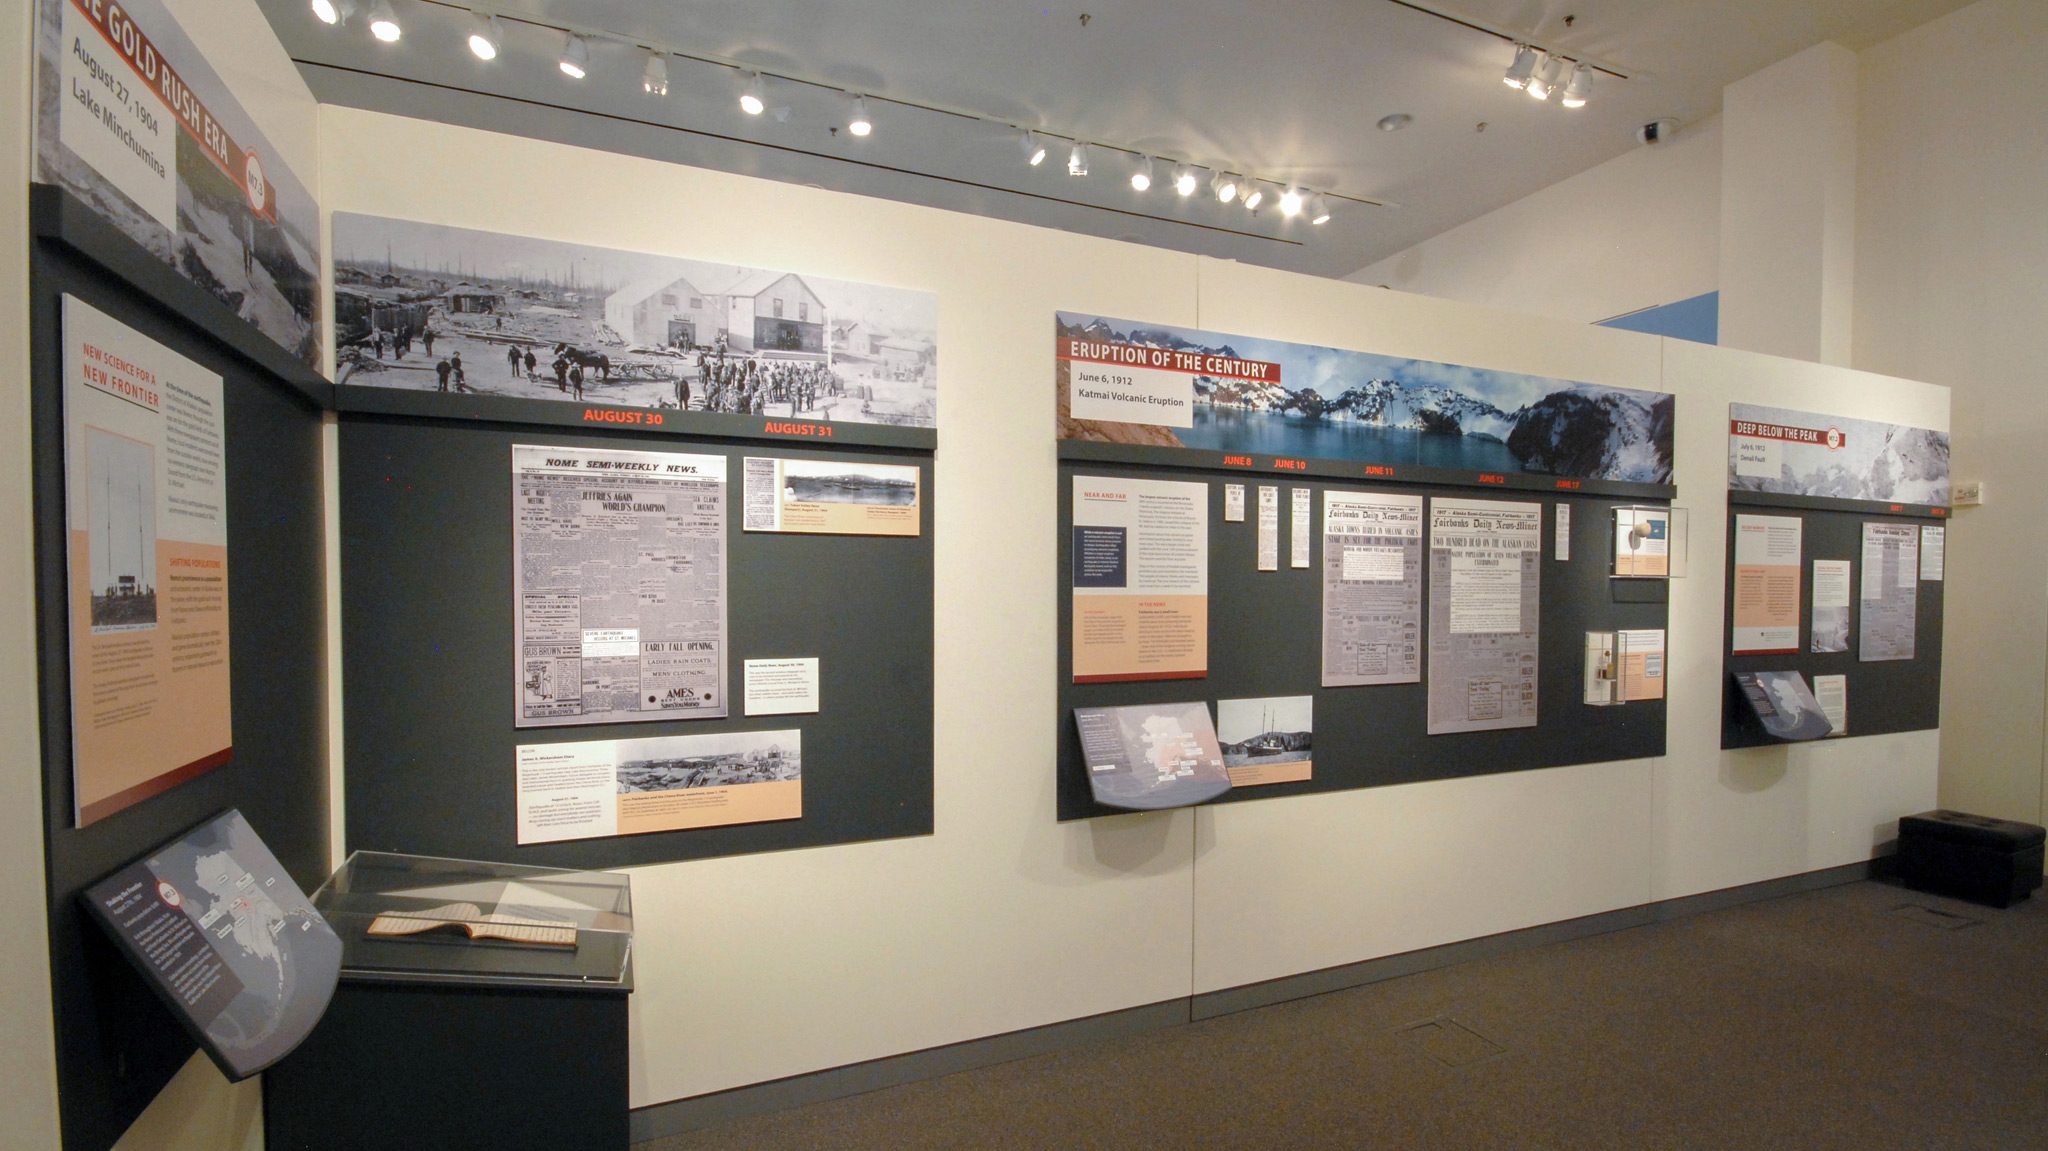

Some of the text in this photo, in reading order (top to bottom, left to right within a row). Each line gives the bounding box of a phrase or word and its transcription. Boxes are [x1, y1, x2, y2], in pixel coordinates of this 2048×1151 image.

[73, 36, 115, 94] August
[116, 80, 132, 113] 27,
[134, 102, 159, 137] 1904
[109, 4, 228, 165] GOLD RUSH ERA
[72, 76, 166, 180] Lake Minchumina
[83, 342, 156, 386] NEW SCIENCE FOR A
[1070, 341, 1268, 379] ERUPTION OF THE CENTURY
[1078, 372, 1133, 386] June 6, 1912
[83, 364, 159, 408] NEW FRONTIER
[1078, 388, 1184, 408] Katmai Volcanic Eruption
[583, 409, 664, 425] AUGUST 30
[764, 421, 833, 437] AUGUST 31
[1737, 422, 1818, 442] DEEP BELOW THE PEAK
[1740, 443, 1750, 452] July
[1223, 455, 1252, 466] JUNE 8
[1740, 454, 1755, 462] Denali
[545, 458, 699, 475] NOME SEMI-WEEKLY NEWS.
[1273, 459, 1306, 470] JUNE 10
[1365, 465, 1394, 476] JUNE 11
[1478, 474, 1494, 483] JUNE
[1556, 480, 1571, 488] JUNE
[581, 492, 633, 502] JEFFRIES AGAIN
[602, 502, 666, 513] WORLD'S CHAMPION
[1329, 509, 1419, 521] Fairbanks Daily News-Miner
[1433, 518, 1538, 531] Fairbanks Daily News-Miner
[1433, 537, 1538, 549] TWO HUNDRED DEAD ON THE ALASKAN COAST
[170, 557, 221, 569] SHIFTING POPULATIONS
[524, 647, 561, 656] GUS BROWN
[645, 642, 665, 652] EARLY
[669, 642, 683, 652] FALL
[666, 687, 694, 699] AMES
